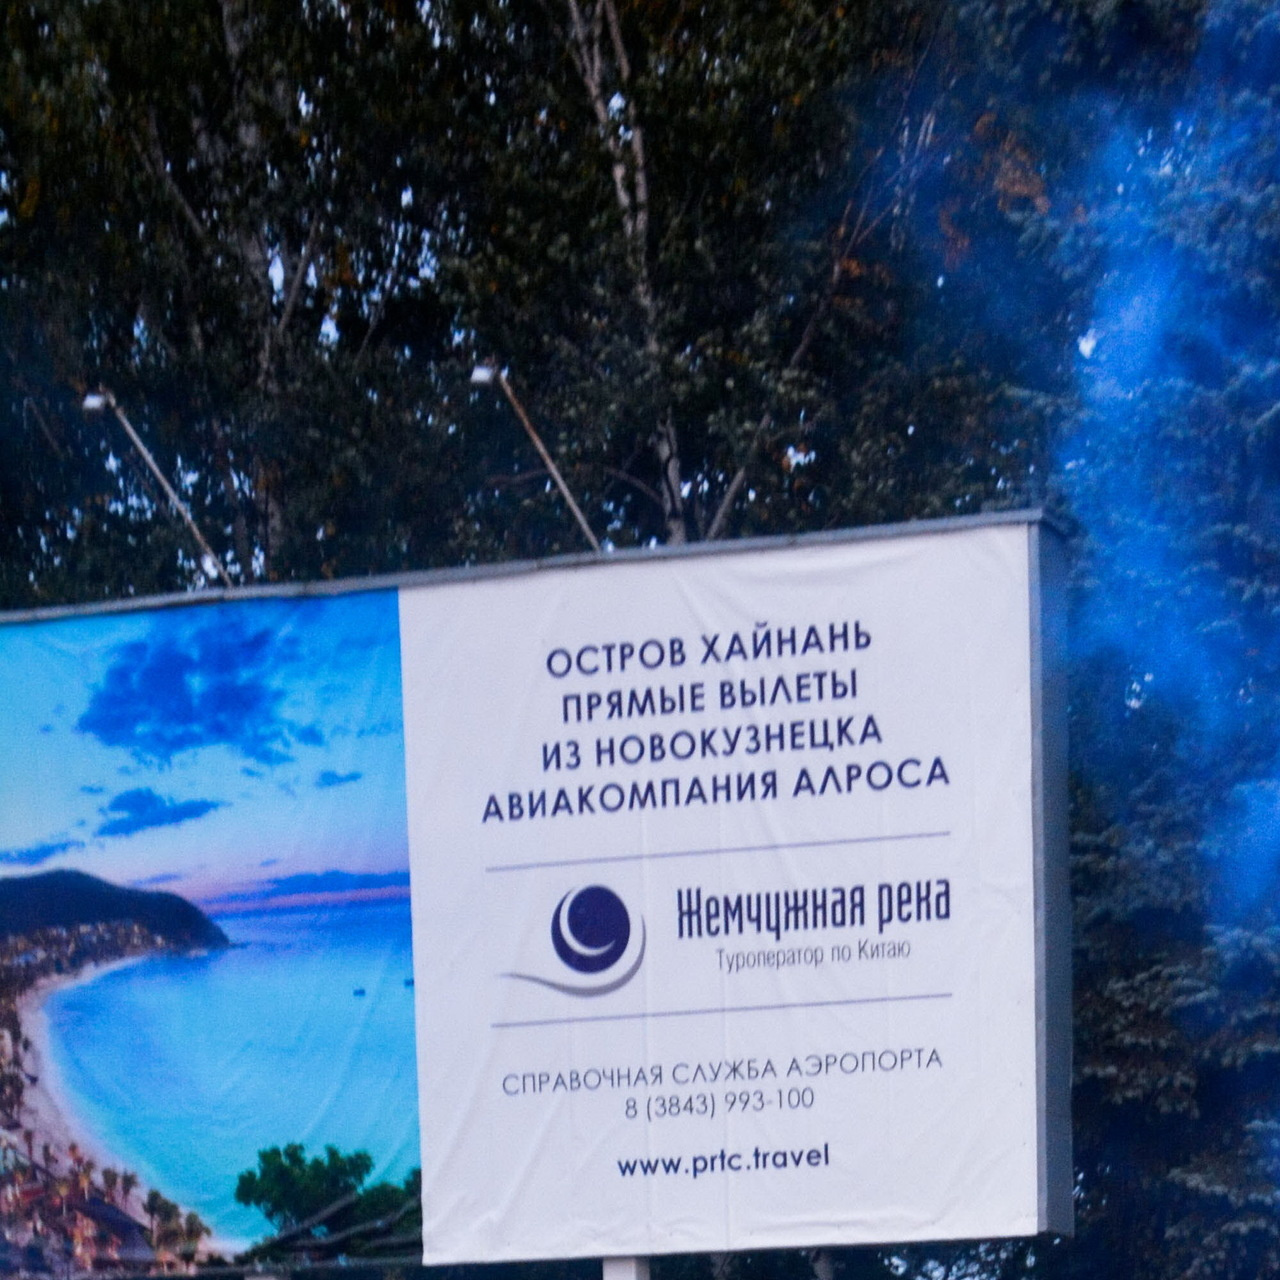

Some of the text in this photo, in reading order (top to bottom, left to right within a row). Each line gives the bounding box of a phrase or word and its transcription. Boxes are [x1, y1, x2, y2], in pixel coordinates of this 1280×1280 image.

[546, 620, 872, 678] ОСТРОВ ХАЙНАНЬ
[562, 669, 858, 724] ПРЯМЫЕ ВЫЛЕТЫ
[542, 714, 883, 772] ИЗ НОВОКУЗНЕЦКА
[482, 756, 950, 824] АВИАКОМПАНИЯ АЛРОСА
[677, 878, 951, 942] Жемчужная река
[715, 938, 911, 974] Туроператор по Китаю
[501, 1048, 943, 1096] СПРАВОЧНАЯ СЛУЖБА АЭРОПОРТА
[625, 1087, 815, 1122] 8 (3843) 993-100
[617, 1143, 831, 1179] www.prtc.travel
